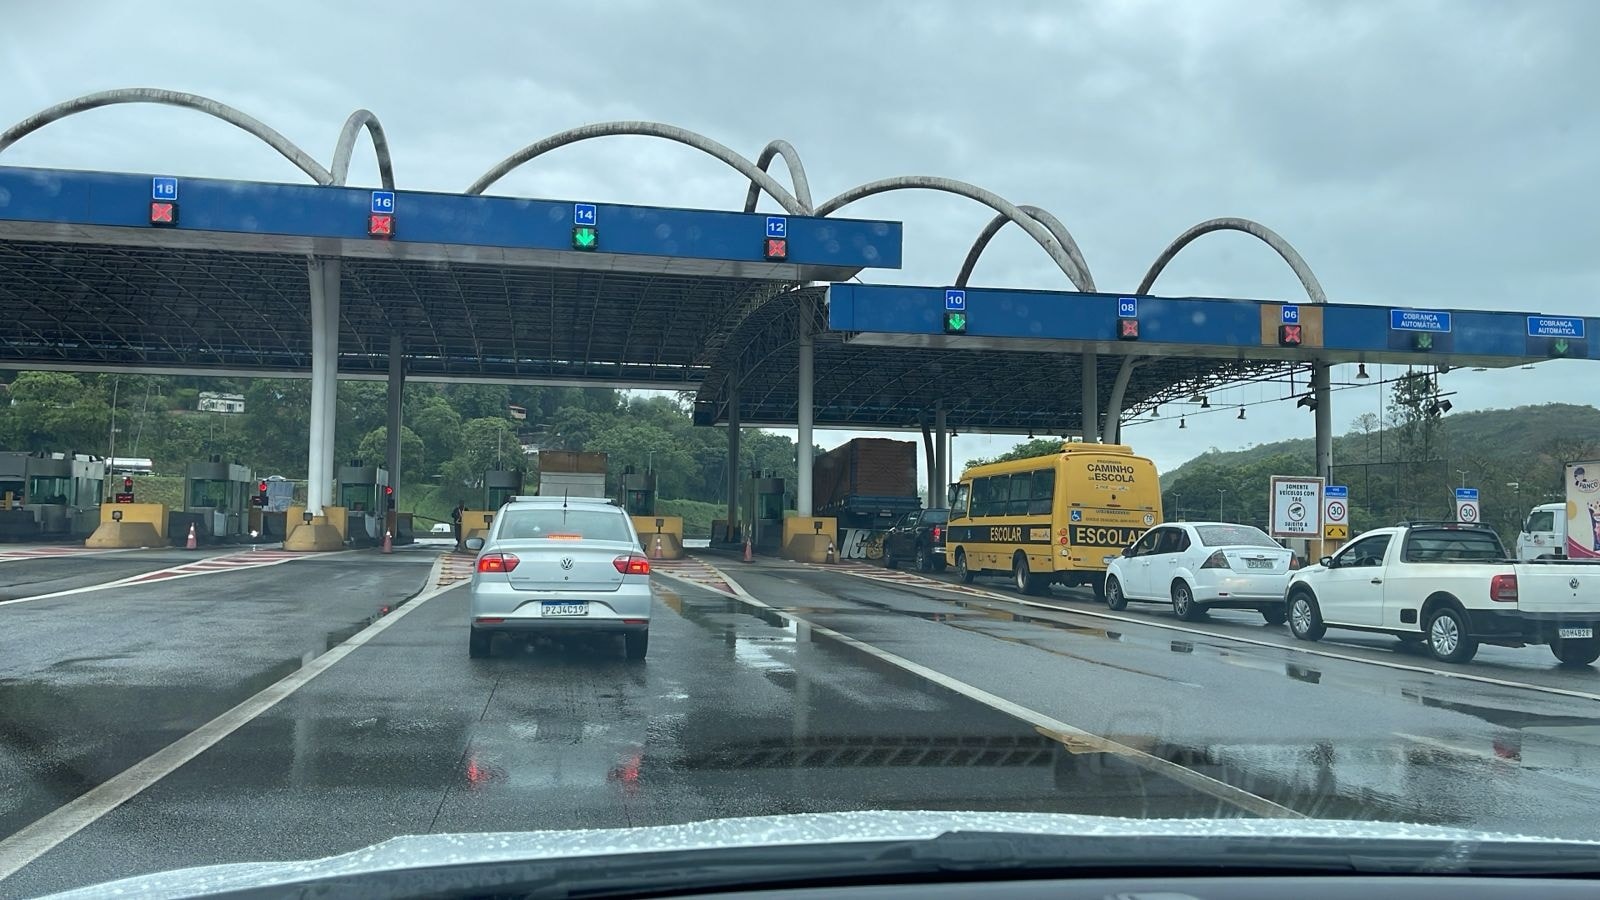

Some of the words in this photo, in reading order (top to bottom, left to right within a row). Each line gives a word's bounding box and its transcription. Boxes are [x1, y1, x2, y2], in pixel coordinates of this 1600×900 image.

[156, 184, 174, 194] 18
[375, 197, 392, 208] 16
[577, 210, 593, 220] 14
[768, 222, 784, 232] 12
[948, 295, 963, 305] 10
[1121, 303, 1134, 312] 08
[1284, 310, 1297, 319] 06
[1403, 312, 1438, 322] COBRANÇA
[1400, 319, 1441, 329] AUTOMÁTICA
[1539, 319, 1572, 328] COBRANÇA
[1537, 327, 1576, 335] AUTOMÁTICA
[1087, 464, 1134, 474] CAMINHO
[1095, 473, 1135, 483] ESCOLA
[1331, 506, 1342, 515] 30
[1463, 508, 1474, 517] 30
[990, 526, 1022, 542] ESCOLAR
[545, 605, 584, 615] PZJ4C19
